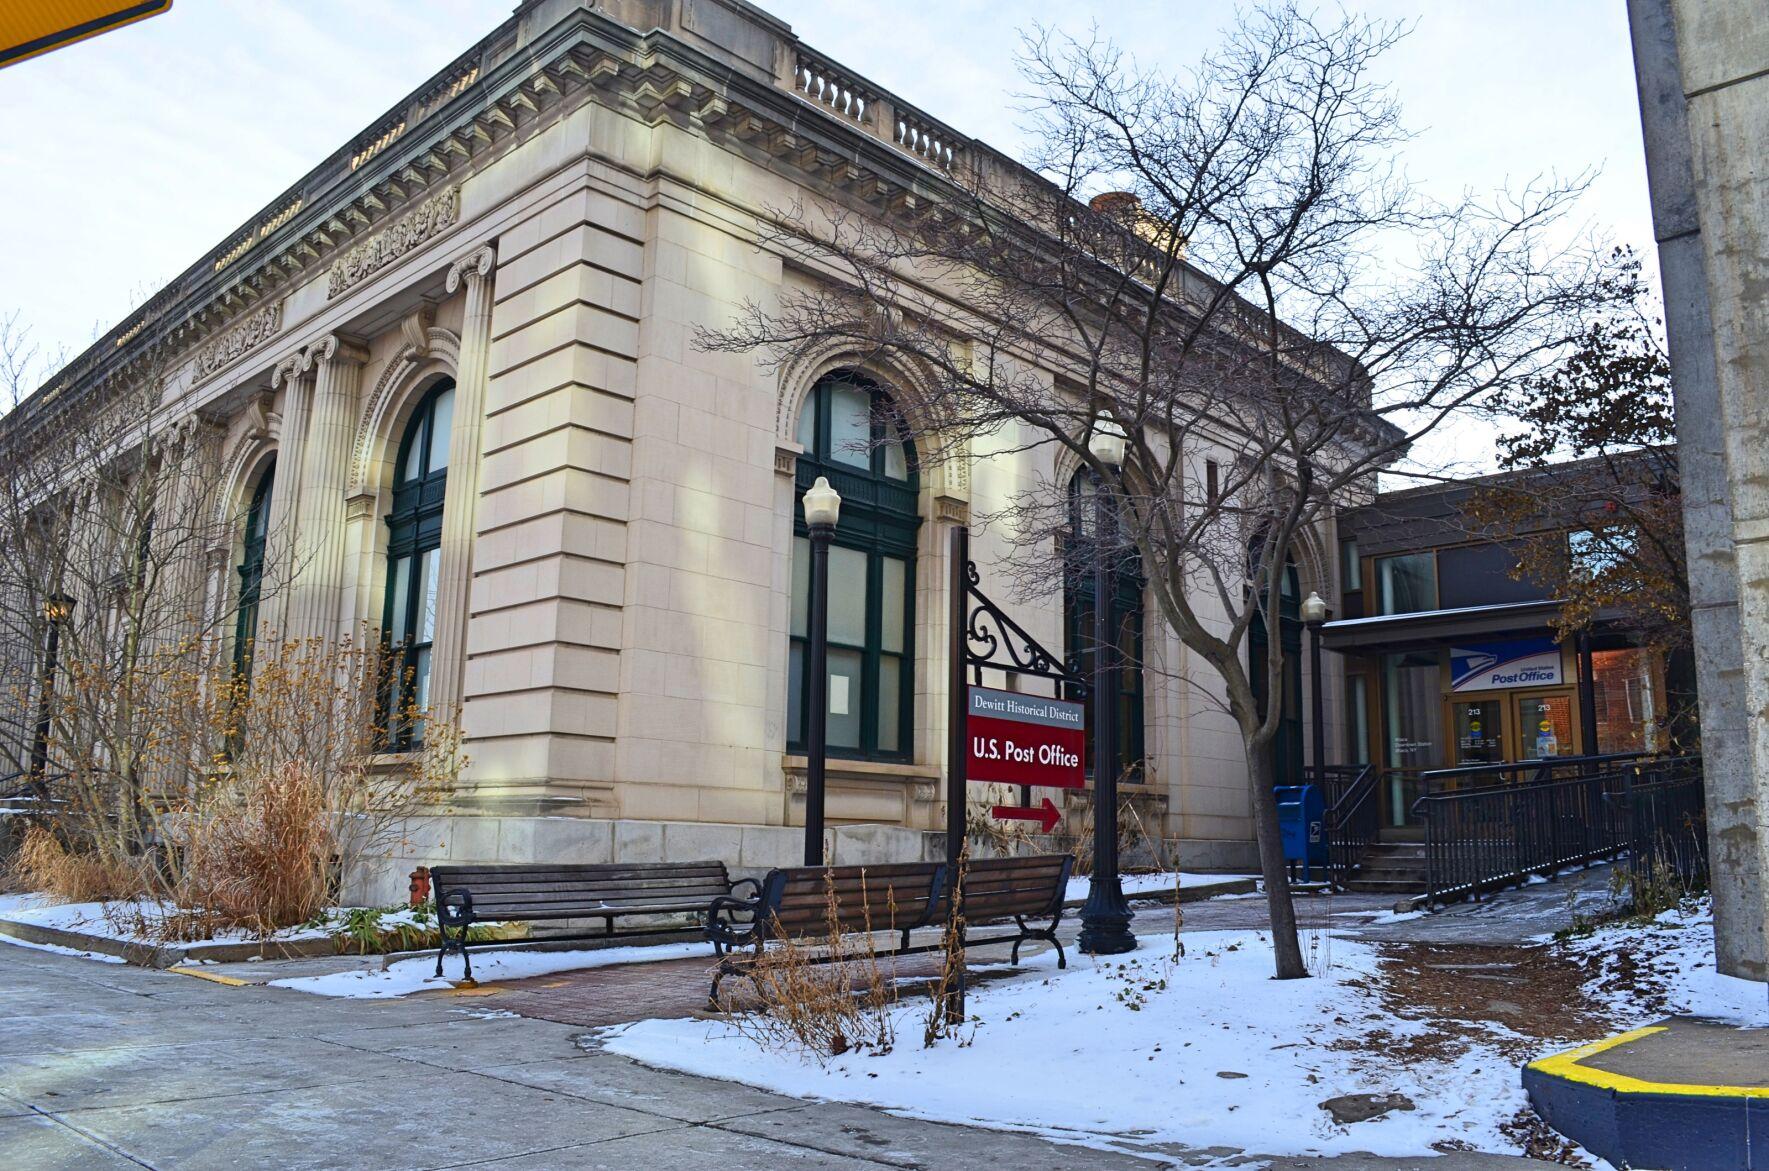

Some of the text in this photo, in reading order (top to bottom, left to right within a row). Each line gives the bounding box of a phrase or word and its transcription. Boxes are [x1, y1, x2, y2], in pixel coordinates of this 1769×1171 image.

[1491, 671, 1554, 684] Post Office
[975, 695, 1079, 722] Dewitt Historical District
[1467, 708, 1481, 716] 213
[1537, 704, 1551, 712] 213
[973, 736, 1079, 768] U.S. Post Office
